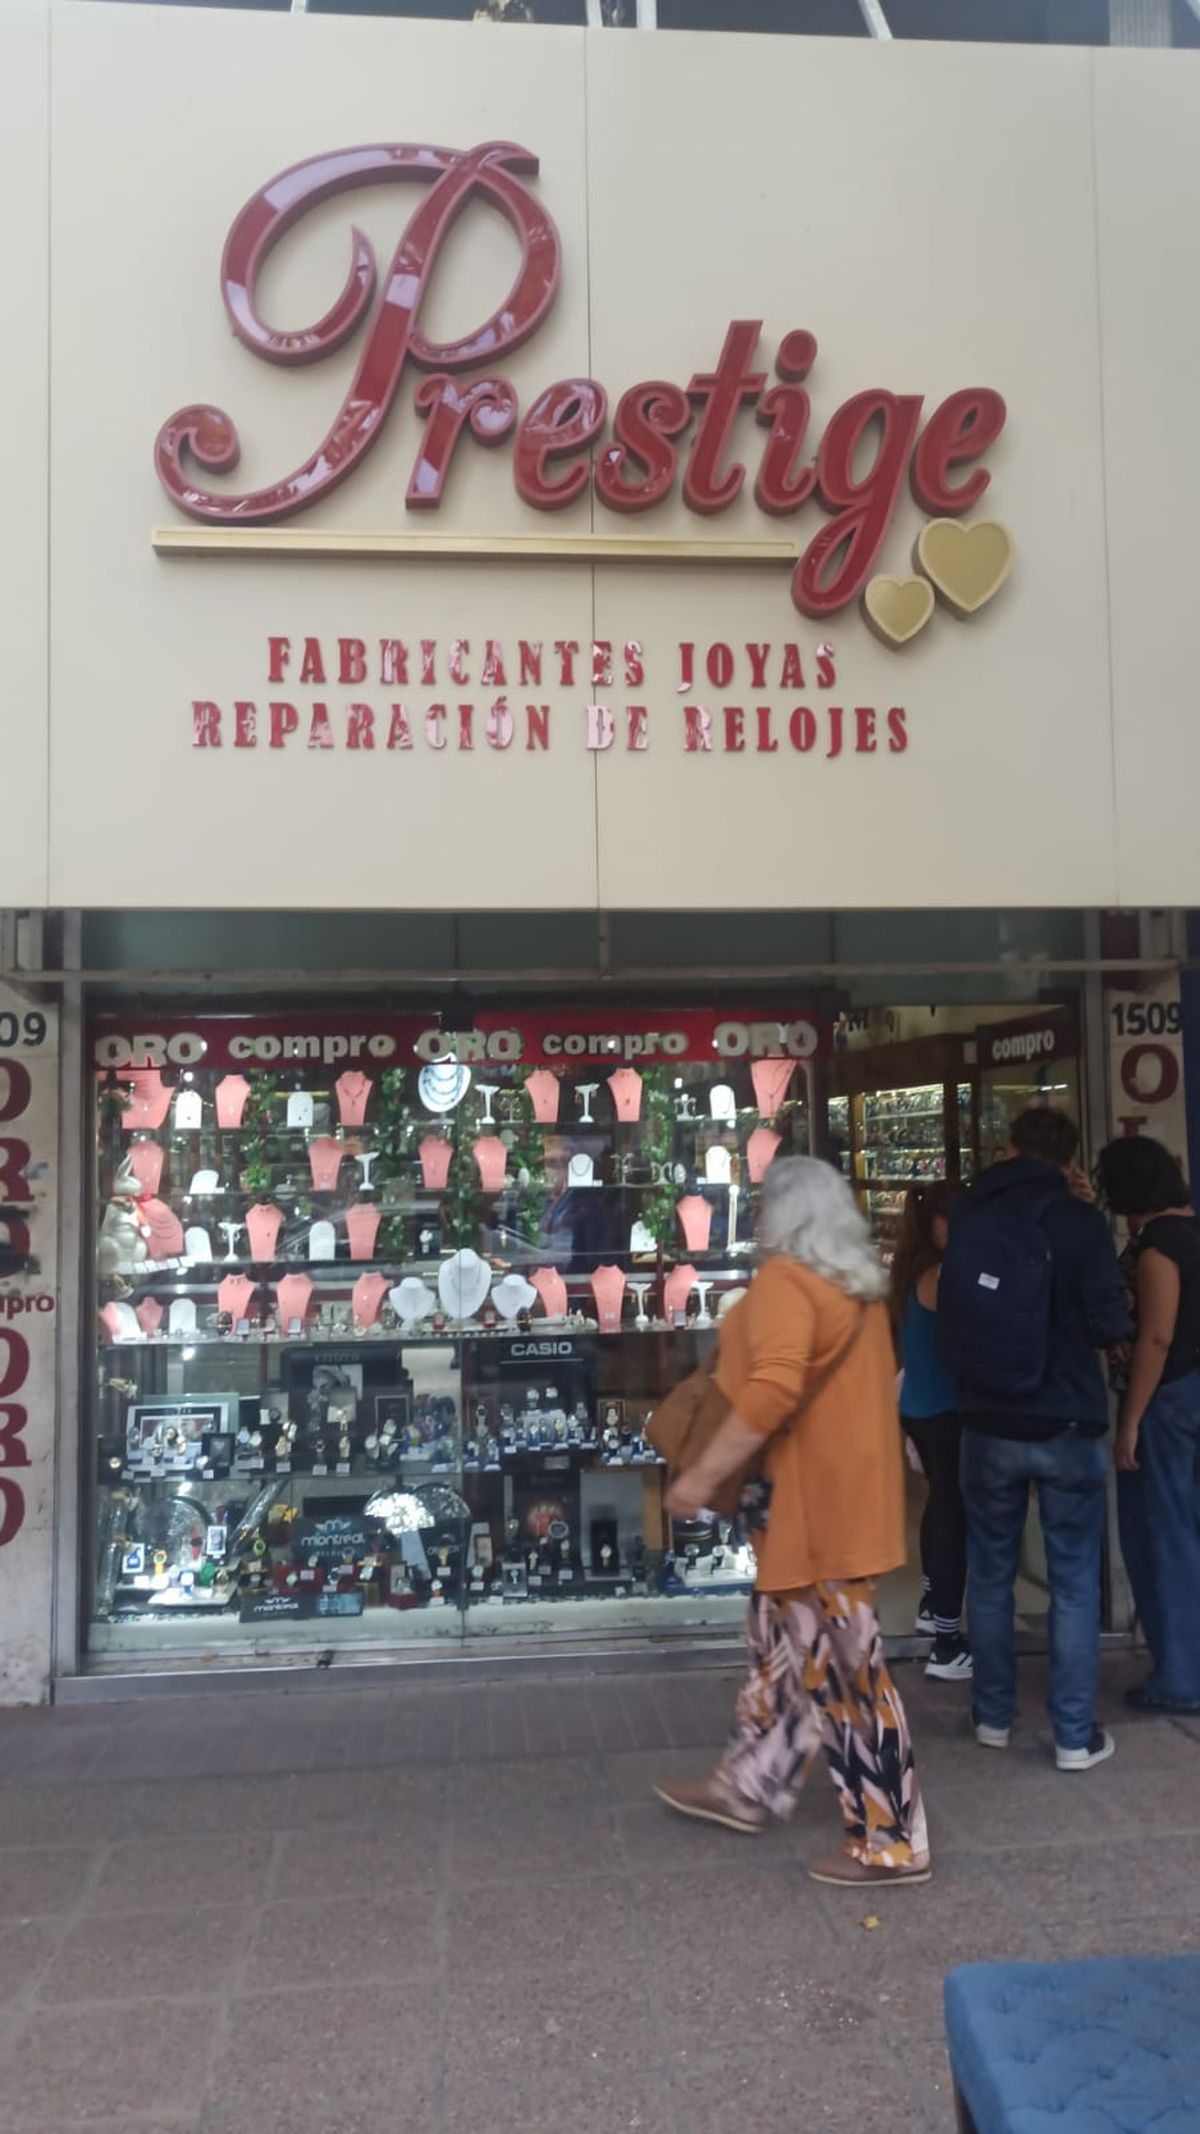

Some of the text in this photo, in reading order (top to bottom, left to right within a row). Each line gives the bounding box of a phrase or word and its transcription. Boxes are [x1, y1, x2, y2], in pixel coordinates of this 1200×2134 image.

[154, 141, 1007, 619] Prestige
[268, 637, 837, 693] FABRICANTES JOYAS
[192, 696, 908, 759] REPARACIÓN DE RELOJES
[1112, 1002, 1183, 1036] 1509
[95, 1021, 818, 1068] ORO compro ORO compro ORO
[992, 1029, 1055, 1061] compro
[511, 1341, 572, 1356] CASIO
